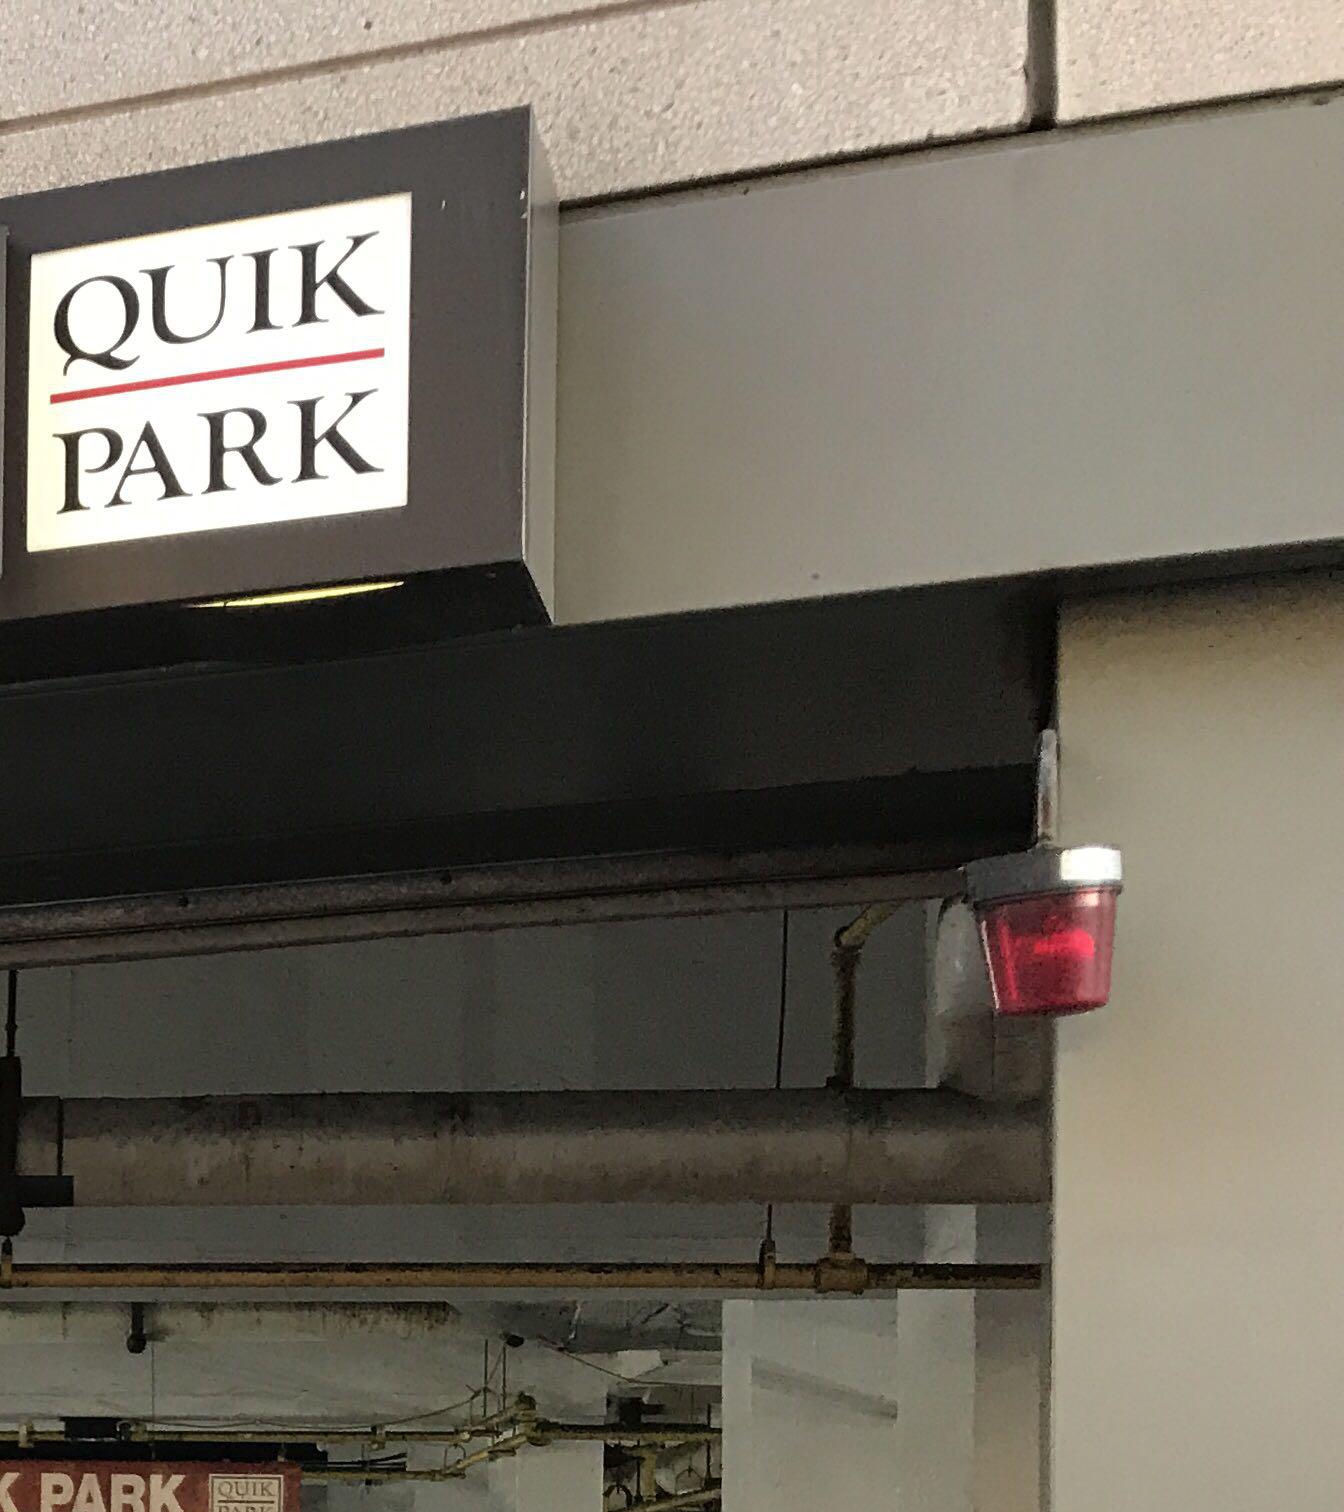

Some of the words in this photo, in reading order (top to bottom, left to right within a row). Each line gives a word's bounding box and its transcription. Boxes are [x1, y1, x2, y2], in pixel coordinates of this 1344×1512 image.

[53, 231, 383, 377] QUIK
[55, 389, 383, 515] PARK
[217, 1480, 274, 1498] QUIK
